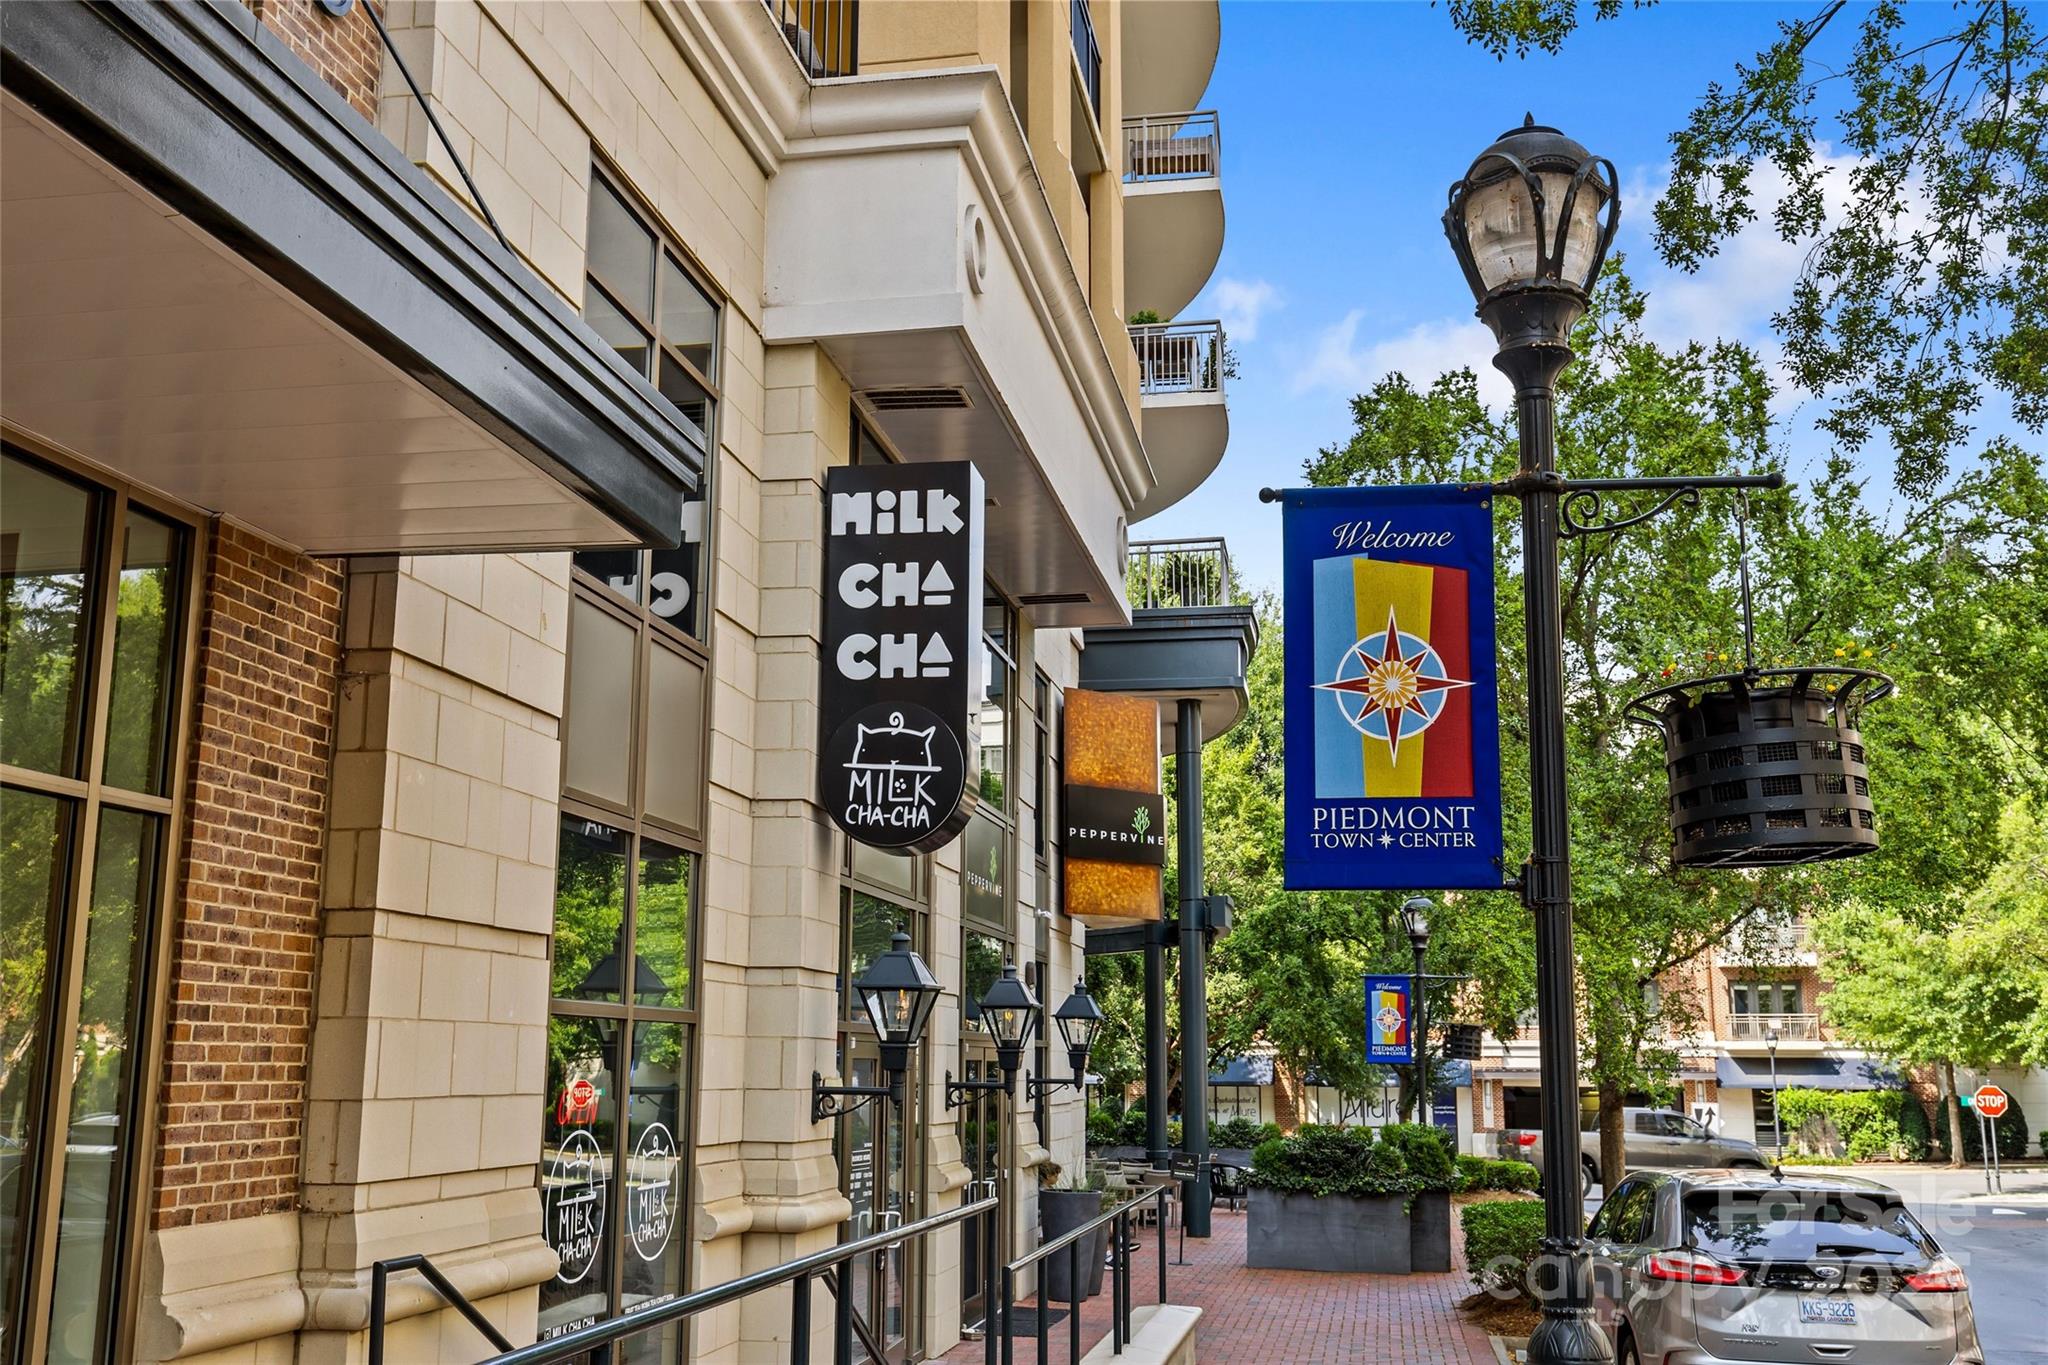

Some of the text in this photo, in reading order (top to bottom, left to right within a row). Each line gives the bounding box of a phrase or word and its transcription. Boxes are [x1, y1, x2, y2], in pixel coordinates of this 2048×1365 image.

[1333, 520, 1454, 550] Welcome
[838, 559, 954, 609] CHA
[836, 632, 953, 680] CHA
[849, 762, 936, 806] MILK
[845, 804, 930, 829] CHA-CHA
[1313, 806, 1475, 830] PIEDMONT
[1069, 826, 1164, 846] PEPPERVINE
[1310, 832, 1476, 848] TOWN CENTER
[967, 870, 1002, 897] PEPPERVINE
[1977, 1095, 2005, 1107] STOP
[558, 1197, 594, 1237] MILK
[639, 1186, 670, 1224] MILK
[638, 1220, 667, 1243] CHA-CHA
[1802, 1301, 1856, 1317] KKS-9226
